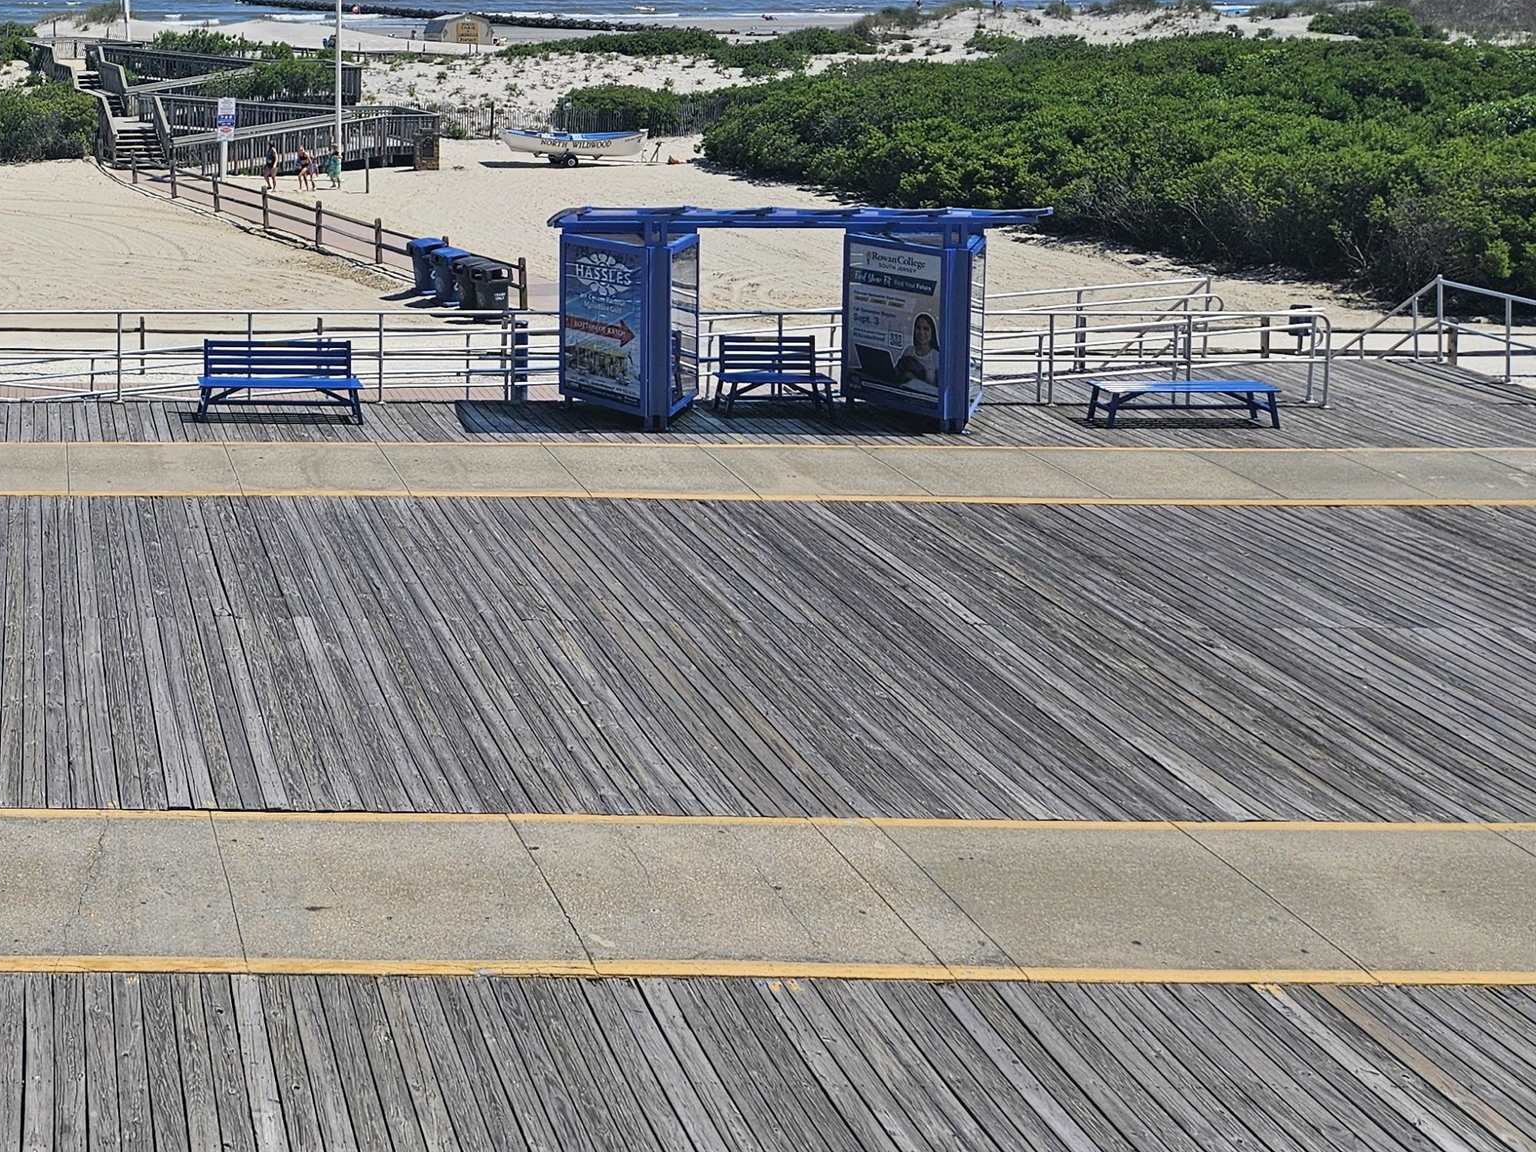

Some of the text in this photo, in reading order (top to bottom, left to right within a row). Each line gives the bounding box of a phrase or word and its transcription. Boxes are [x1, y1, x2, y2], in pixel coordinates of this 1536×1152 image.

[540, 137, 568, 148] NORTH
[572, 138, 612, 149] WILDWOOD
[872, 252, 926, 271] Rowan College
[576, 264, 632, 285] HASSLES
